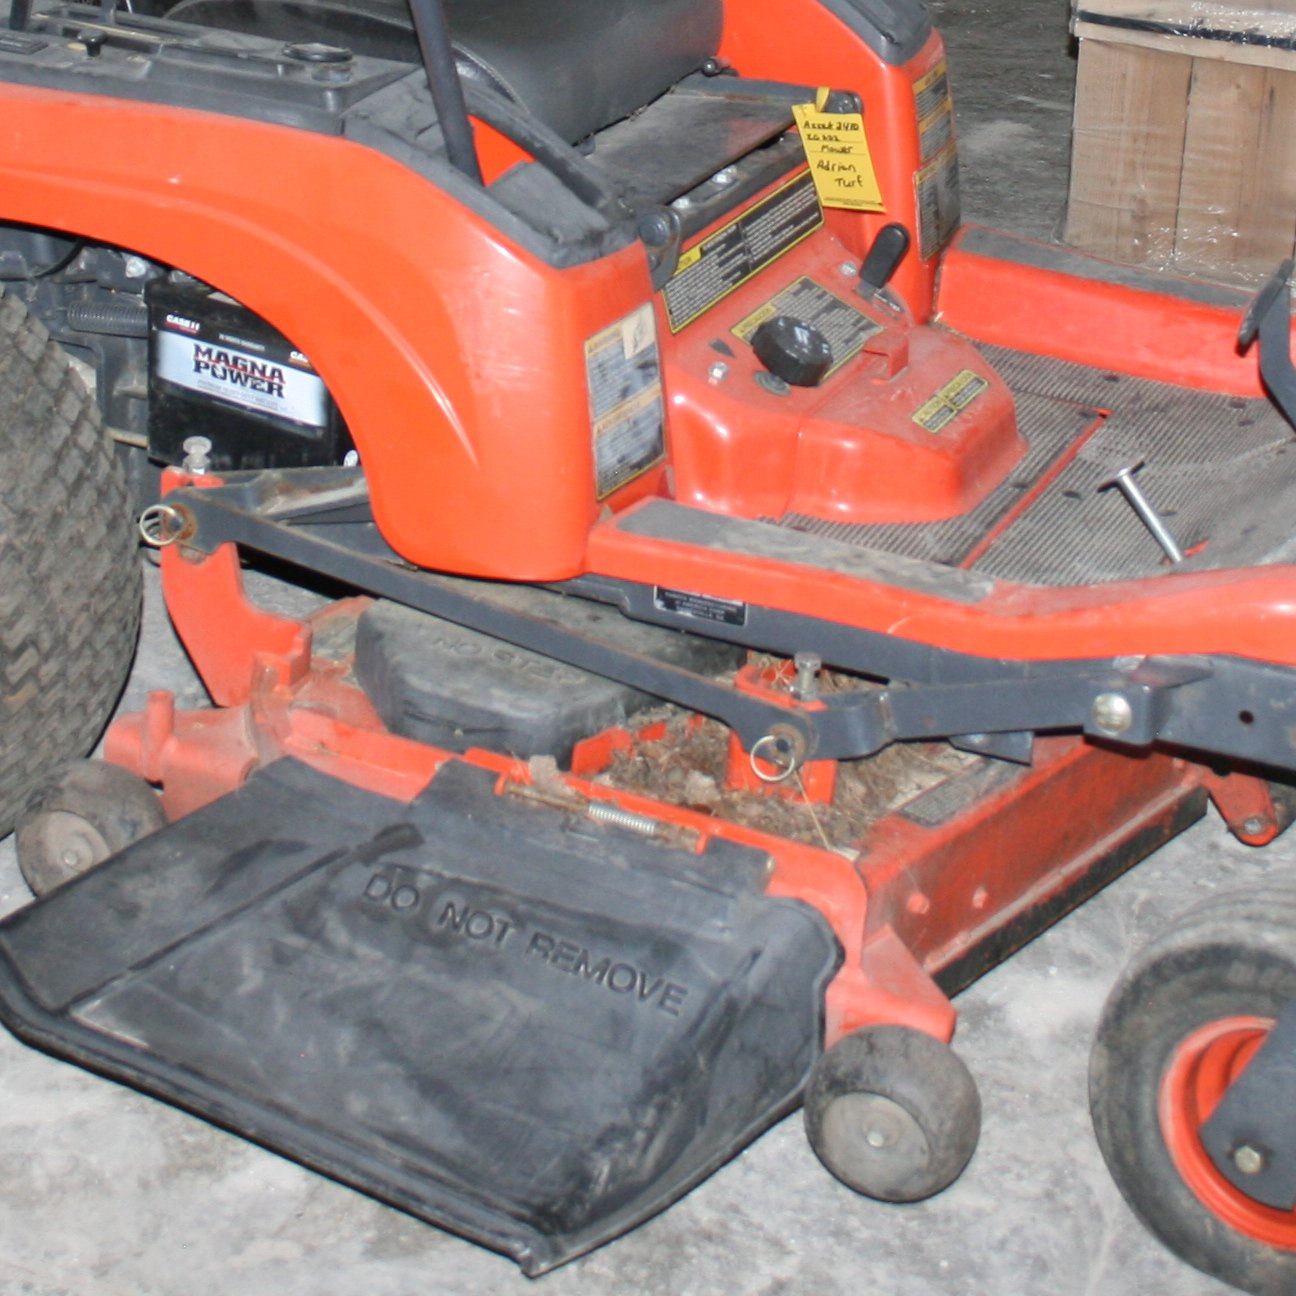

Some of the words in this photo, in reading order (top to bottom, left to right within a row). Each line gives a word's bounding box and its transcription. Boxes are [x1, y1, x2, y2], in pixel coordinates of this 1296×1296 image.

[834, 175, 863, 188] Turf
[193, 342, 286, 385] MAGNA
[193, 358, 286, 399] POWER
[362, 872, 420, 911] DO
[437, 900, 520, 945] NOT
[526, 931, 688, 1018] REMOVE
